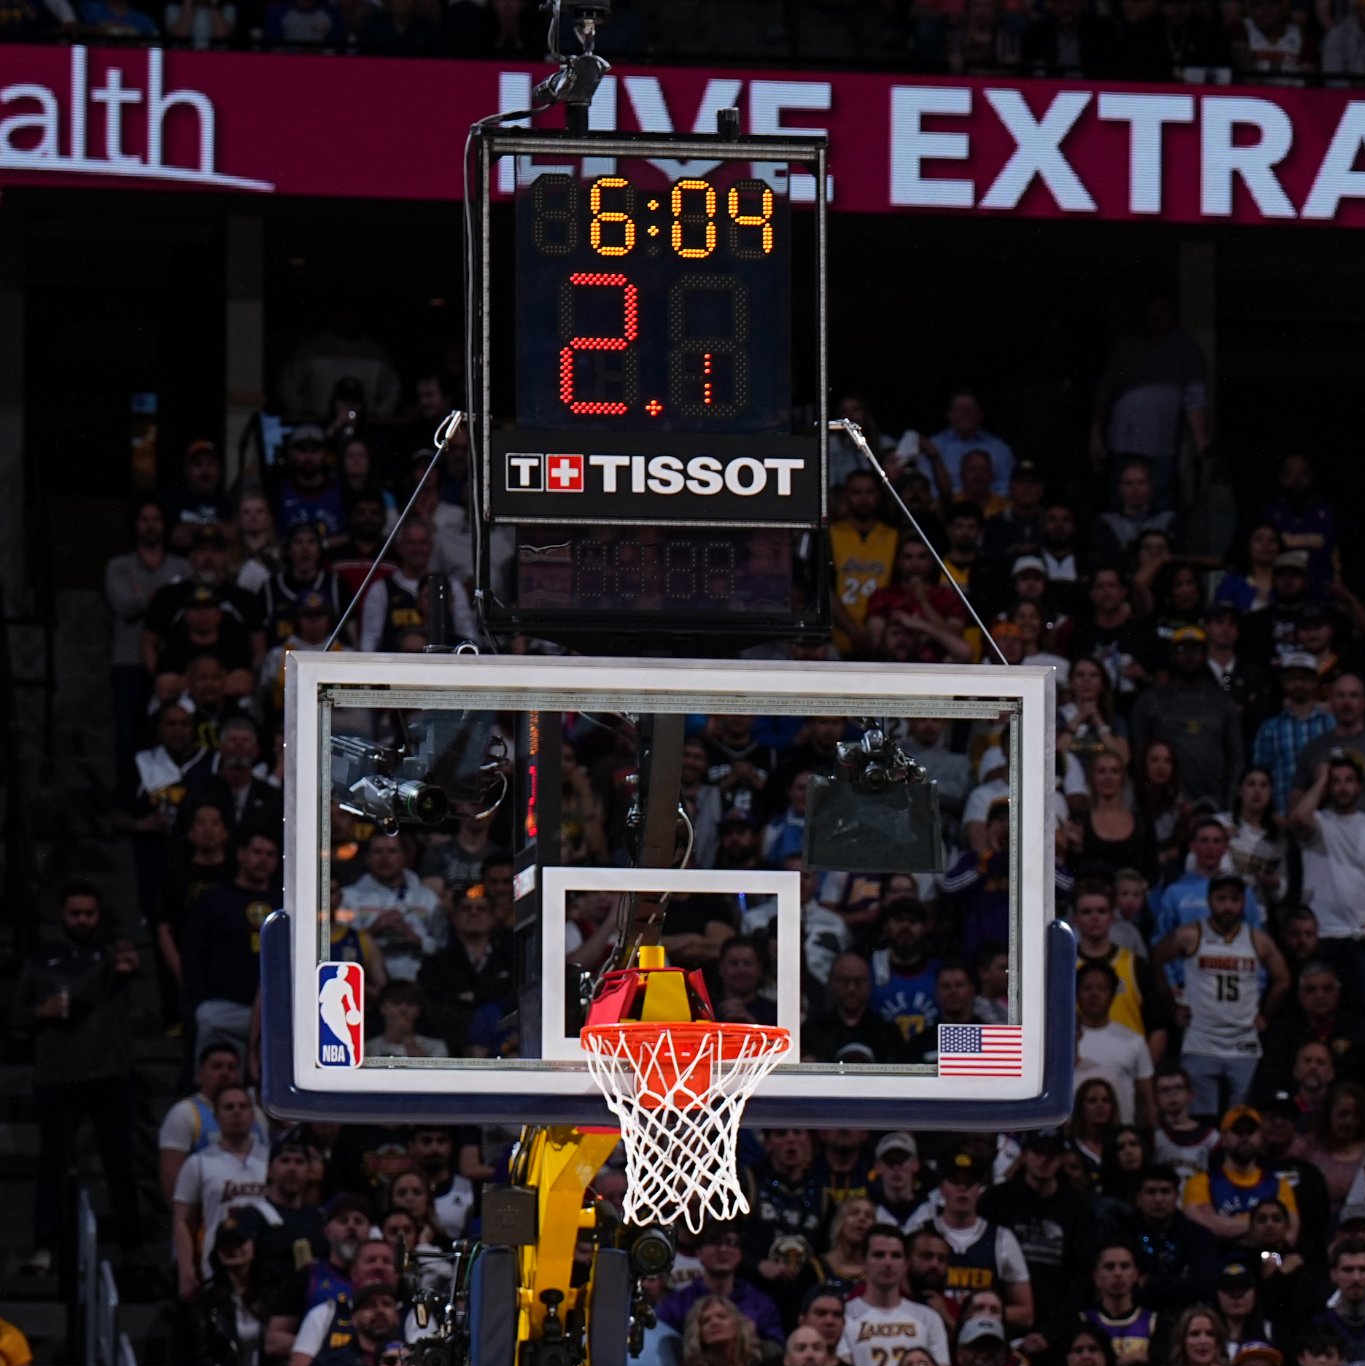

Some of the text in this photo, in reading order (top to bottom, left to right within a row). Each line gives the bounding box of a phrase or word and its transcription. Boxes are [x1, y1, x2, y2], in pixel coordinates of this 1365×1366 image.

[498, 73, 835, 206] LIVE
[589, 177, 775, 258] 6:04
[589, 454, 805, 497] TISSOT
[1211, 974, 1240, 1003] 15
[321, 1044, 346, 1063] NBA
[943, 1267, 992, 1288] NVER
[858, 1322, 918, 1342] LAKERS
